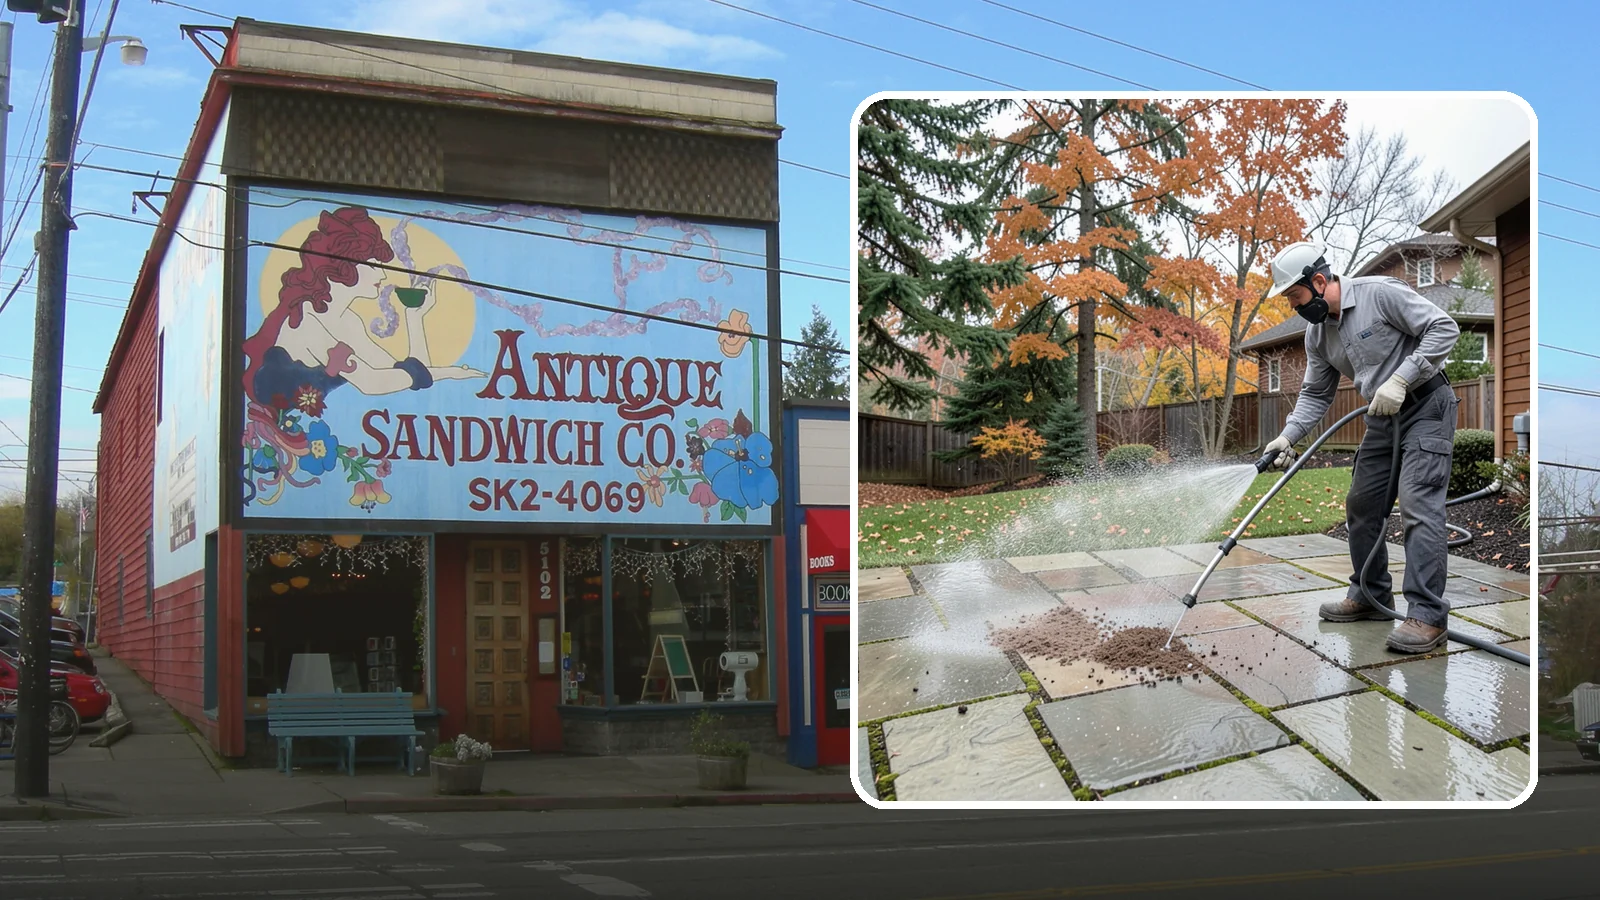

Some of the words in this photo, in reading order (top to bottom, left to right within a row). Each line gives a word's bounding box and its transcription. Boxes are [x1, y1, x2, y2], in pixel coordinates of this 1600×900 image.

[477, 329, 723, 421] ANTIQUE
[361, 408, 605, 467] SANDWICH
[616, 421, 685, 469] CO.
[468, 477, 647, 513] SK2-4069
[539, 541, 551, 600] 5102
[809, 555, 834, 569] BOOKS
